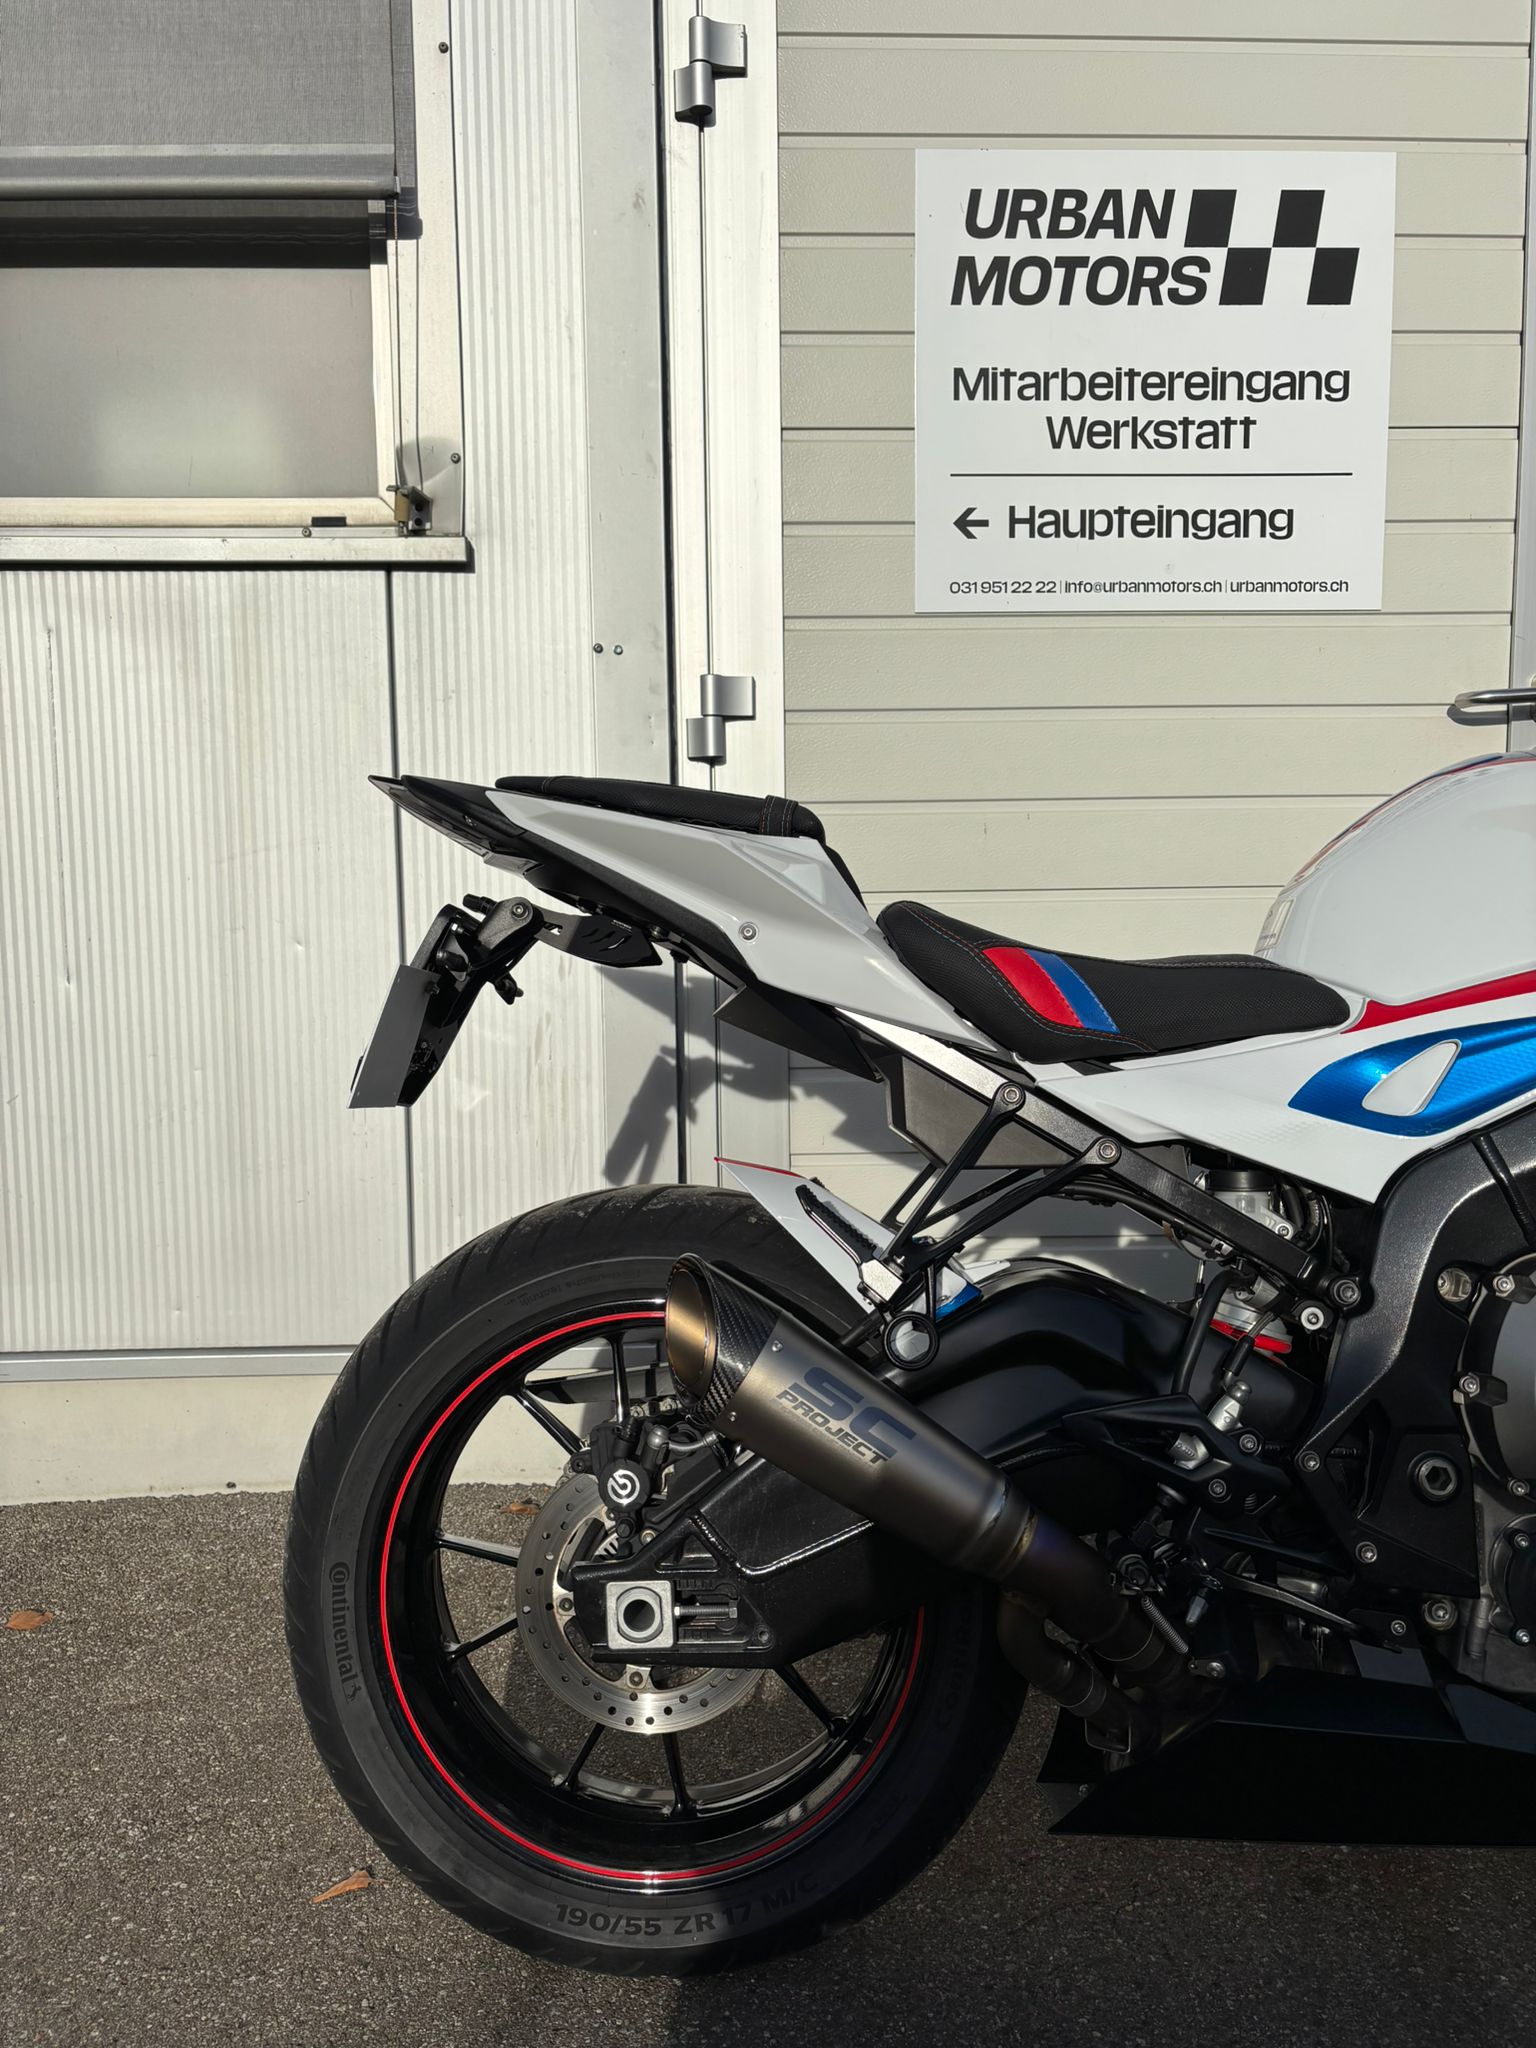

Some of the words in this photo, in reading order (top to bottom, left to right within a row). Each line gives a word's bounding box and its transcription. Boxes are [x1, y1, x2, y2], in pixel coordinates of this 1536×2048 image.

[965, 188, 1176, 240] URBAN
[950, 255, 1211, 307] MOTORS
[953, 366, 1350, 403] Mitarbeitereingang
[1045, 416, 1257, 450] Werkstatt
[1008, 504, 1294, 541] Haupteingang
[1230, 579, 1349, 593] urbanmotors.ch
[776, 1389, 889, 1465] PROJECT
[788, 1366, 917, 1459] SC
[329, 1561, 358, 1684] Continental
[555, 1903, 662, 1936] 190/55
[674, 1912, 716, 1935] ZR
[722, 1904, 751, 1926] 17
